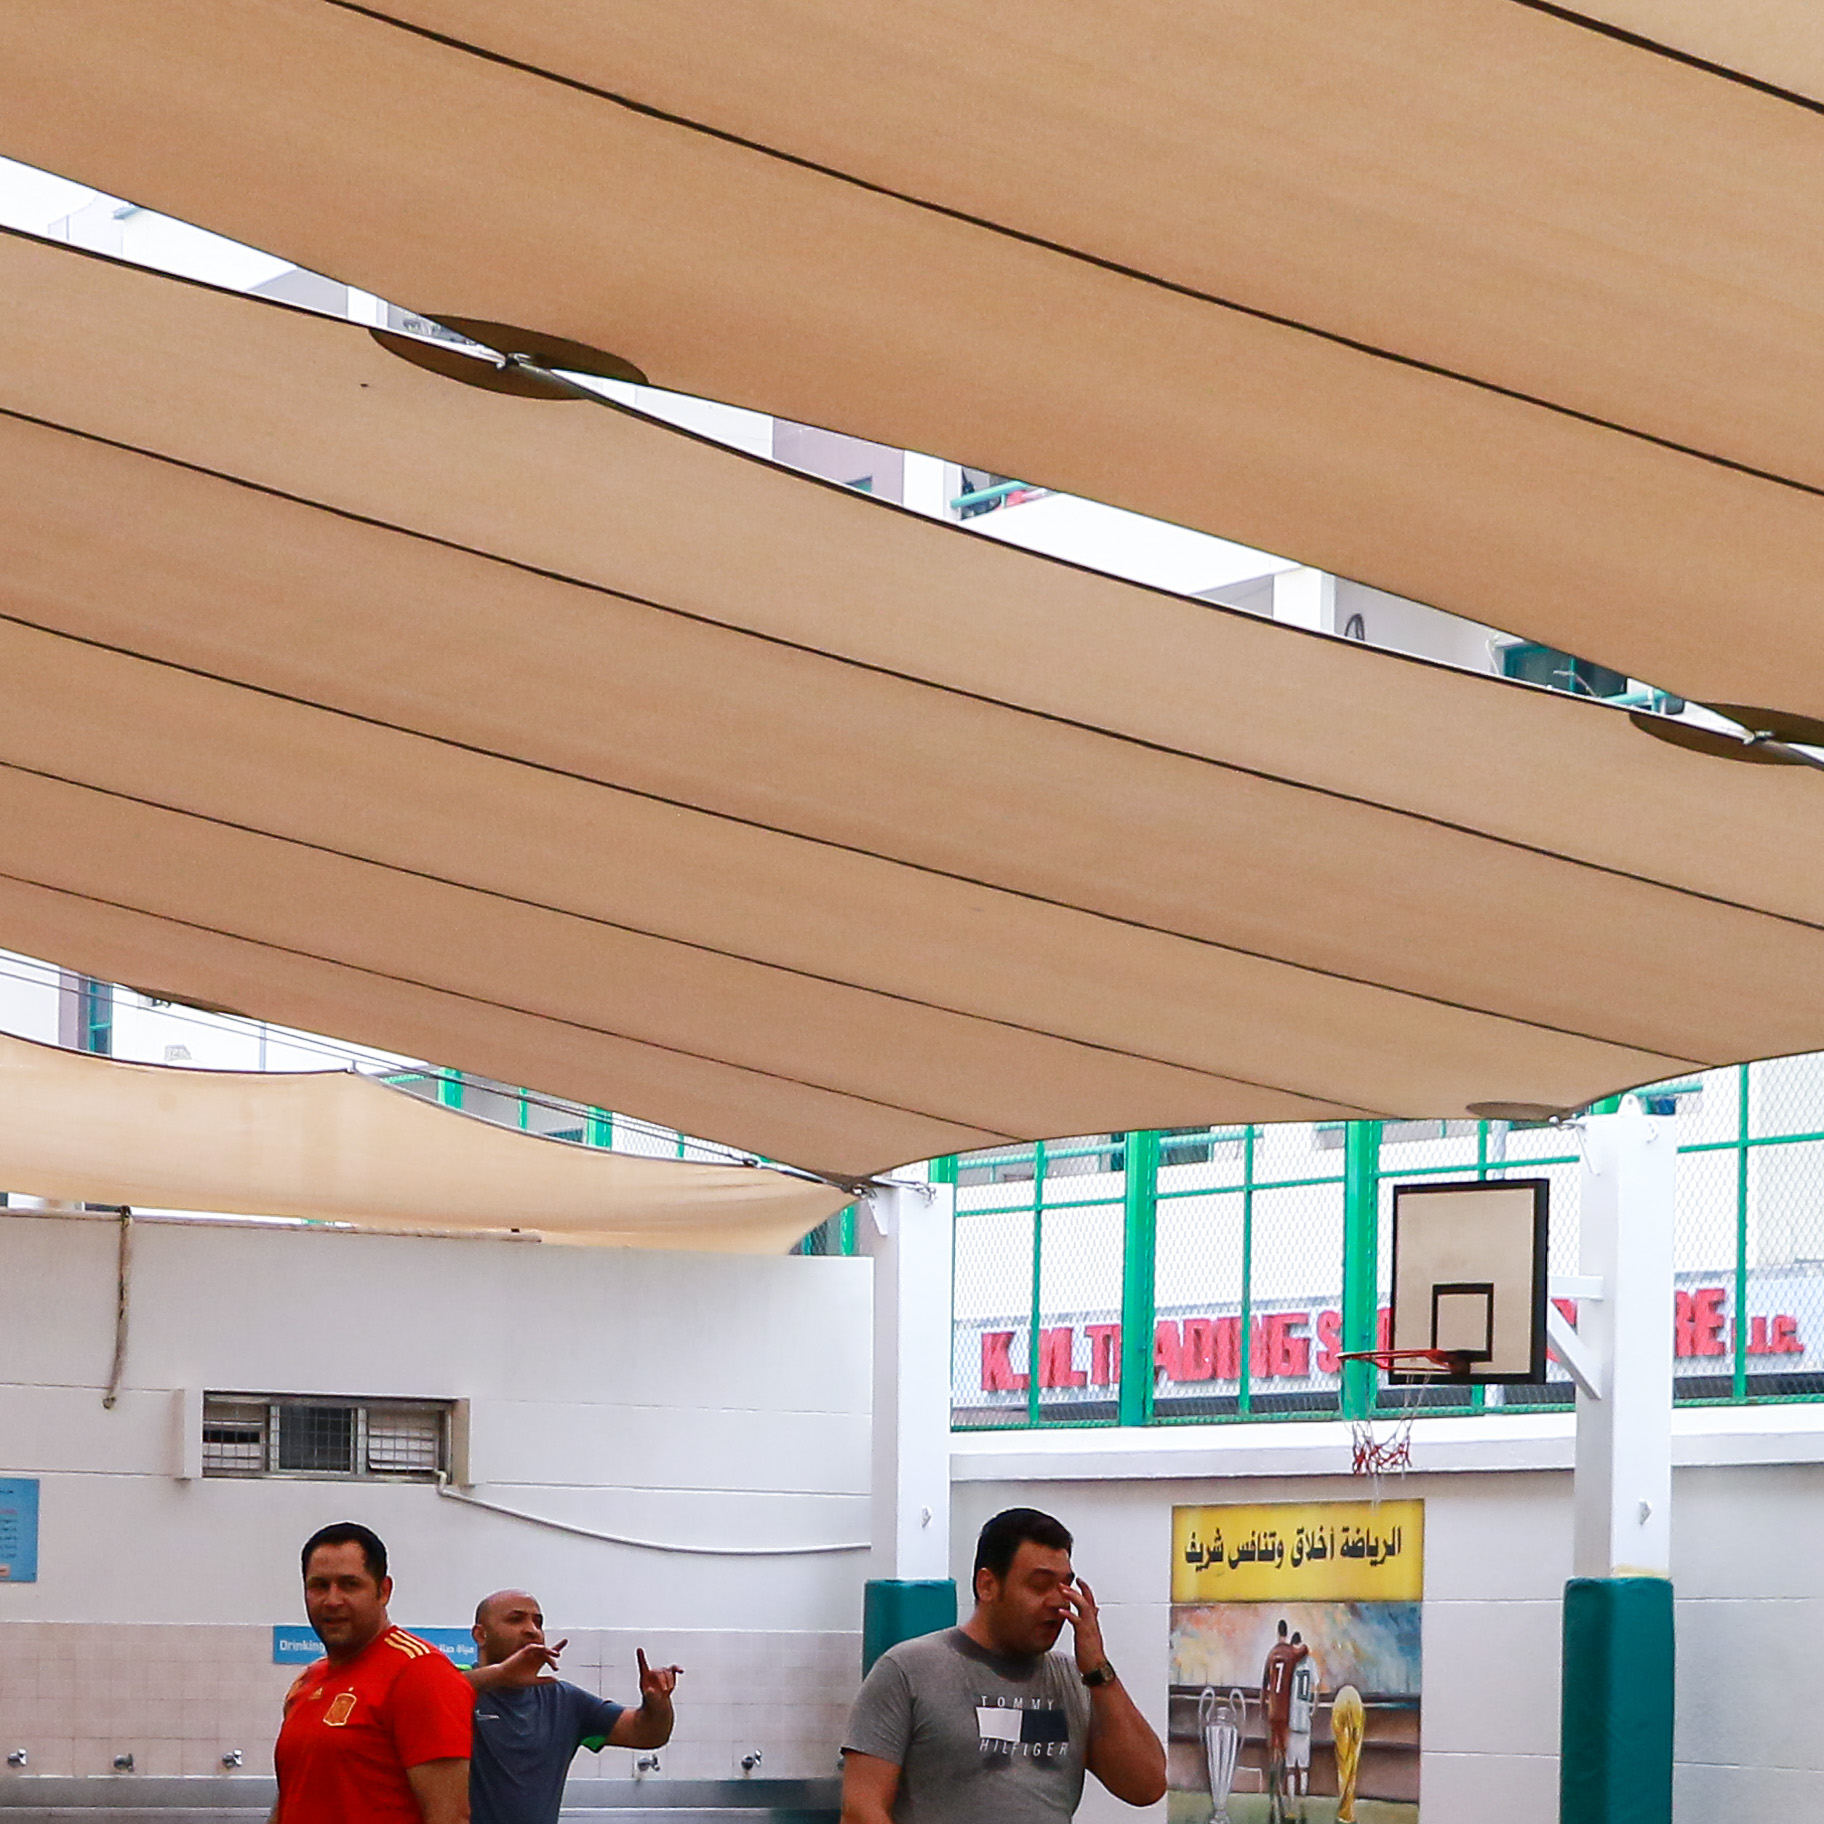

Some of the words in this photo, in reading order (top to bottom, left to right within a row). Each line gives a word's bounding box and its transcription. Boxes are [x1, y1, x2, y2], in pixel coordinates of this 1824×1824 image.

[1184, 1527, 1224, 1572] شريف
[1228, 1530, 1284, 1569] وتنافس
[1291, 1525, 1334, 1568] أخلاق
[1340, 1525, 1402, 1566] الرياضة
[1275, 1662, 1285, 1694] 7
[980, 1695, 1055, 1711] TOMMY
[979, 1738, 1070, 1757] HILFIGER
